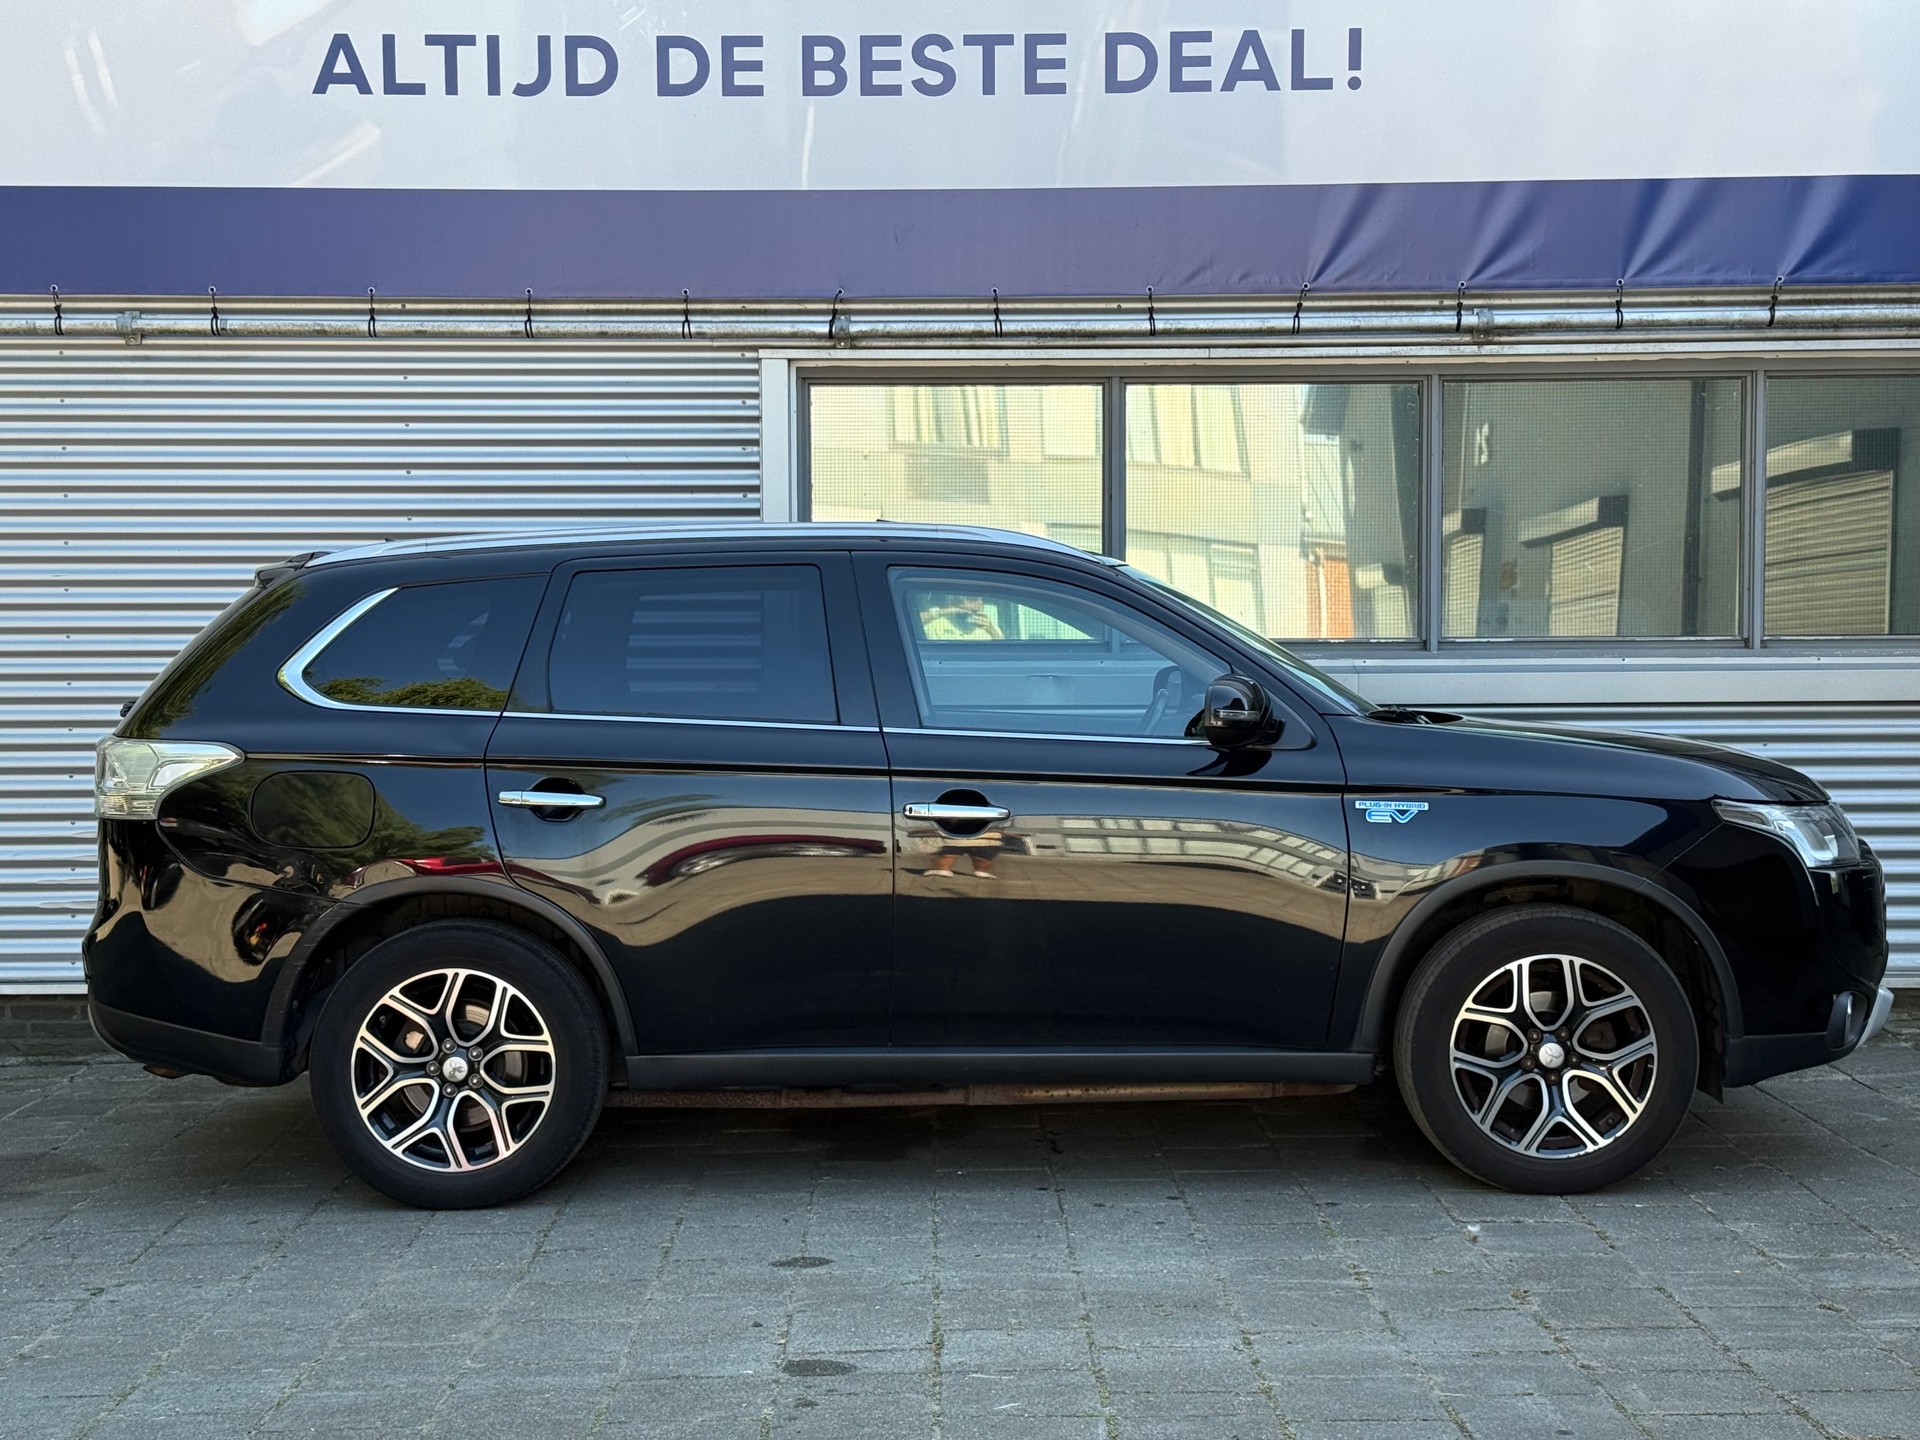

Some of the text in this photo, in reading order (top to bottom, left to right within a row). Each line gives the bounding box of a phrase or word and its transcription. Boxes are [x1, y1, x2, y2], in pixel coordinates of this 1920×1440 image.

[312, 28, 1363, 97] ALTIJD DE BESTE DEAL!
[1366, 808, 1418, 823] EV
